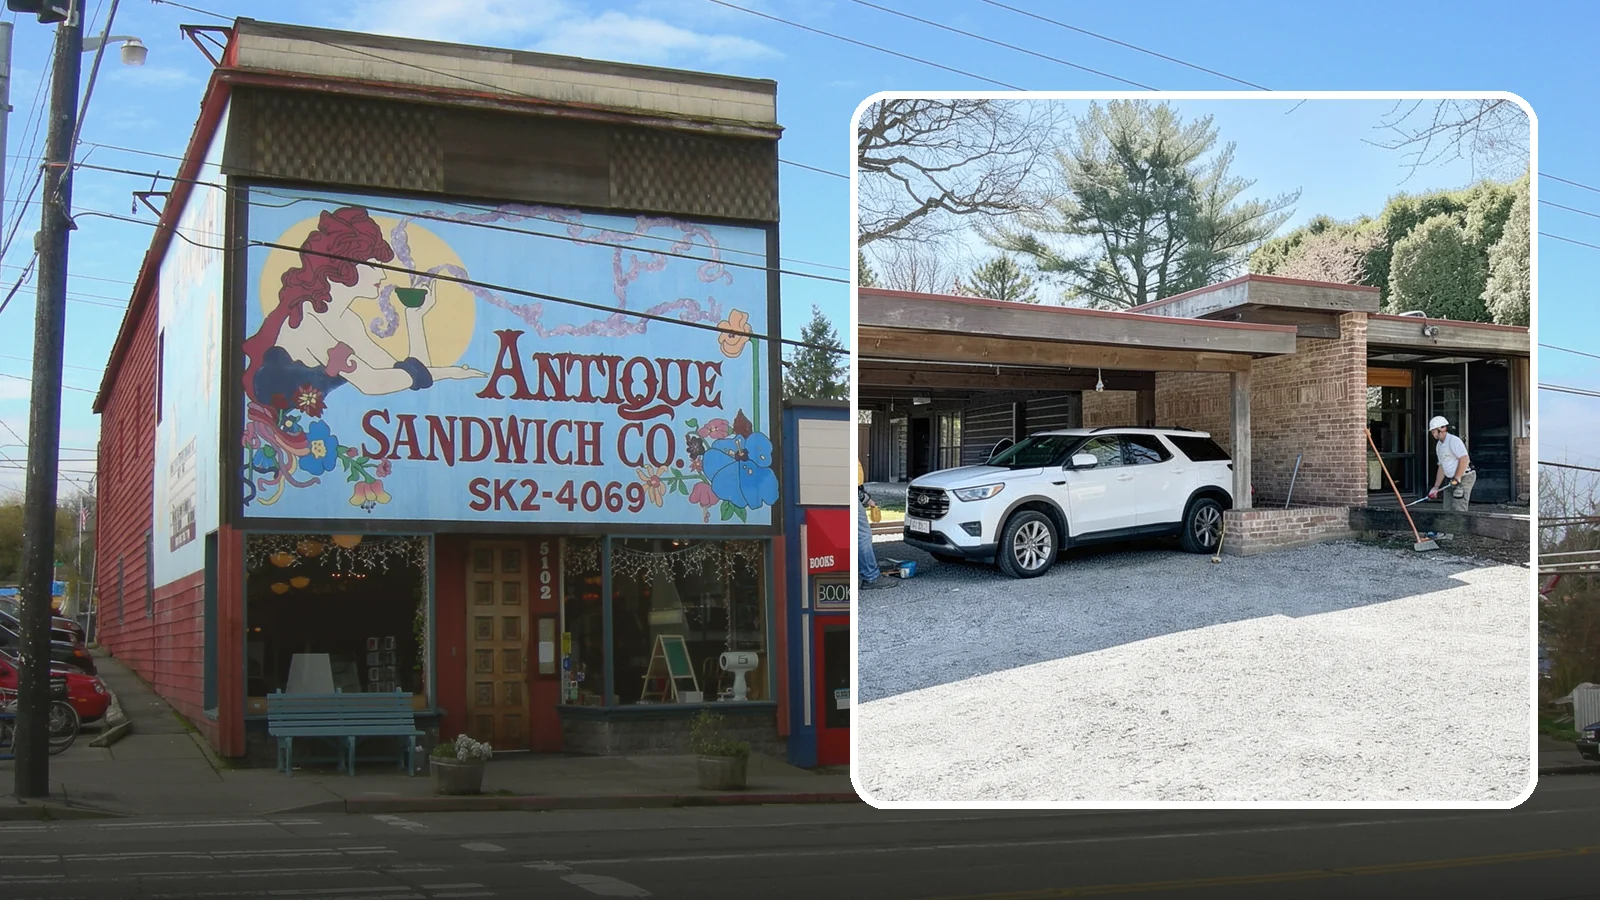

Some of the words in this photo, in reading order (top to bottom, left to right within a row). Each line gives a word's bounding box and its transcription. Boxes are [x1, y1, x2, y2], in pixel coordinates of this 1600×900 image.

[476, 329, 724, 420] ANTIQUE
[361, 408, 604, 467] SANDWICH
[617, 421, 685, 469] CO.
[468, 477, 646, 513] SK2-4069
[539, 542, 551, 600] 5102
[809, 555, 835, 569] BOOKS
